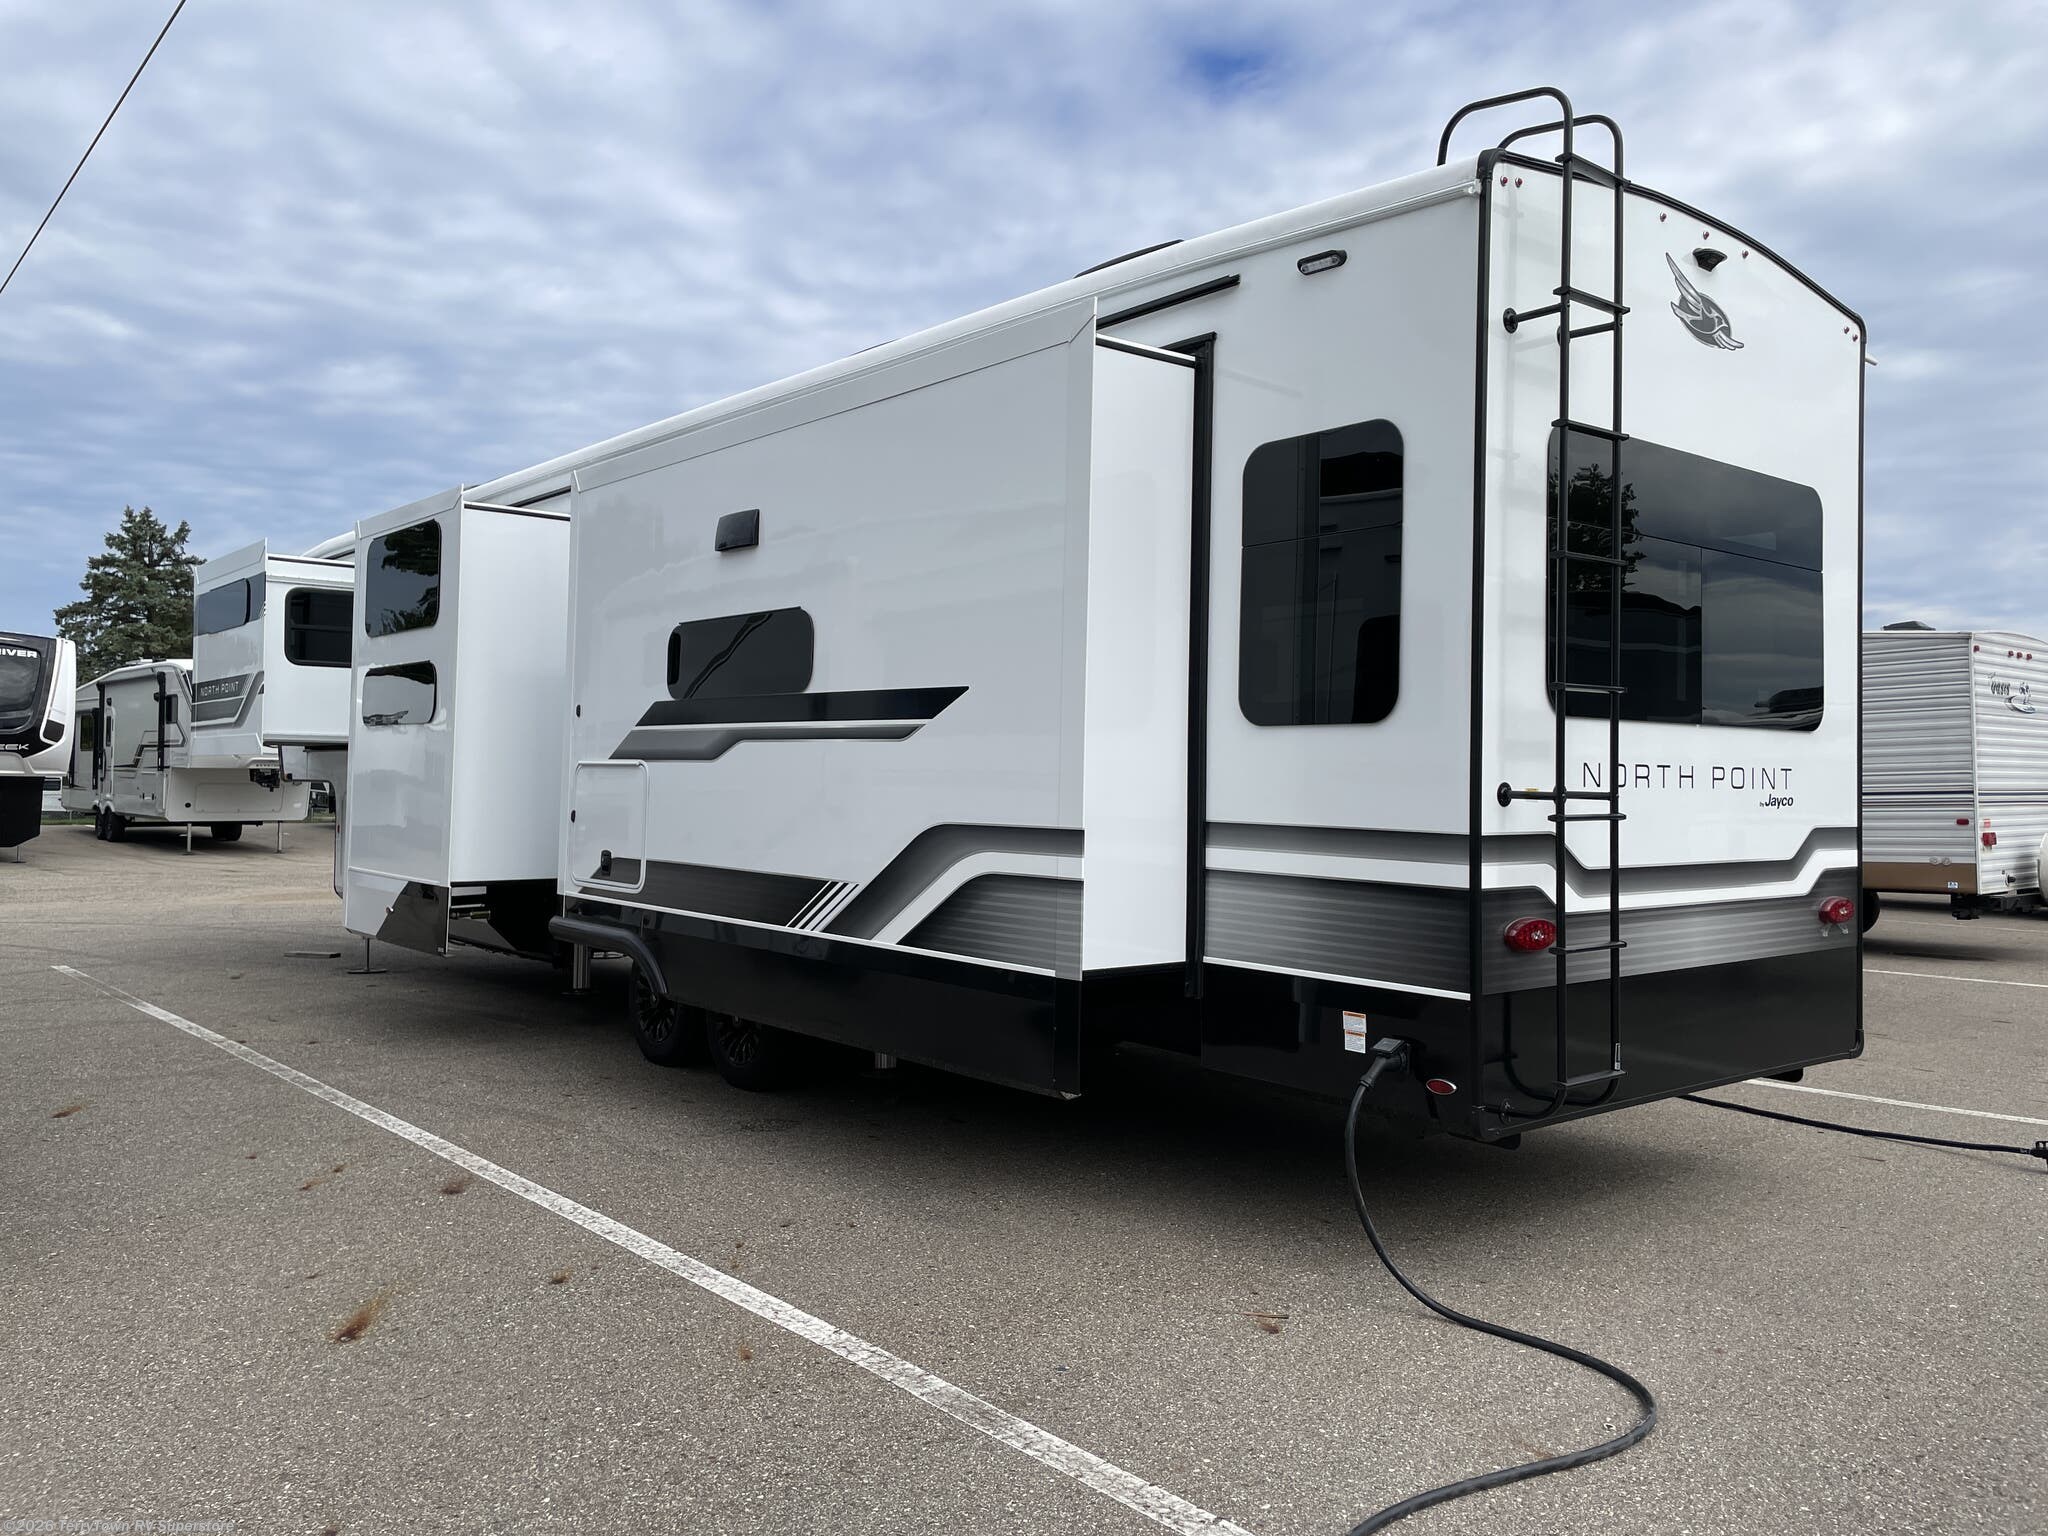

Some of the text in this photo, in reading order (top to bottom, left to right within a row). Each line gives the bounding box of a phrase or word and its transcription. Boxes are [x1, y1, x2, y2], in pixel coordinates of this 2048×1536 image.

[0, 648, 38, 659] IVER
[221, 681, 239, 694] POINT
[1582, 762, 1793, 790] NORTH POINT
[1765, 793, 1794, 809] Jayco
